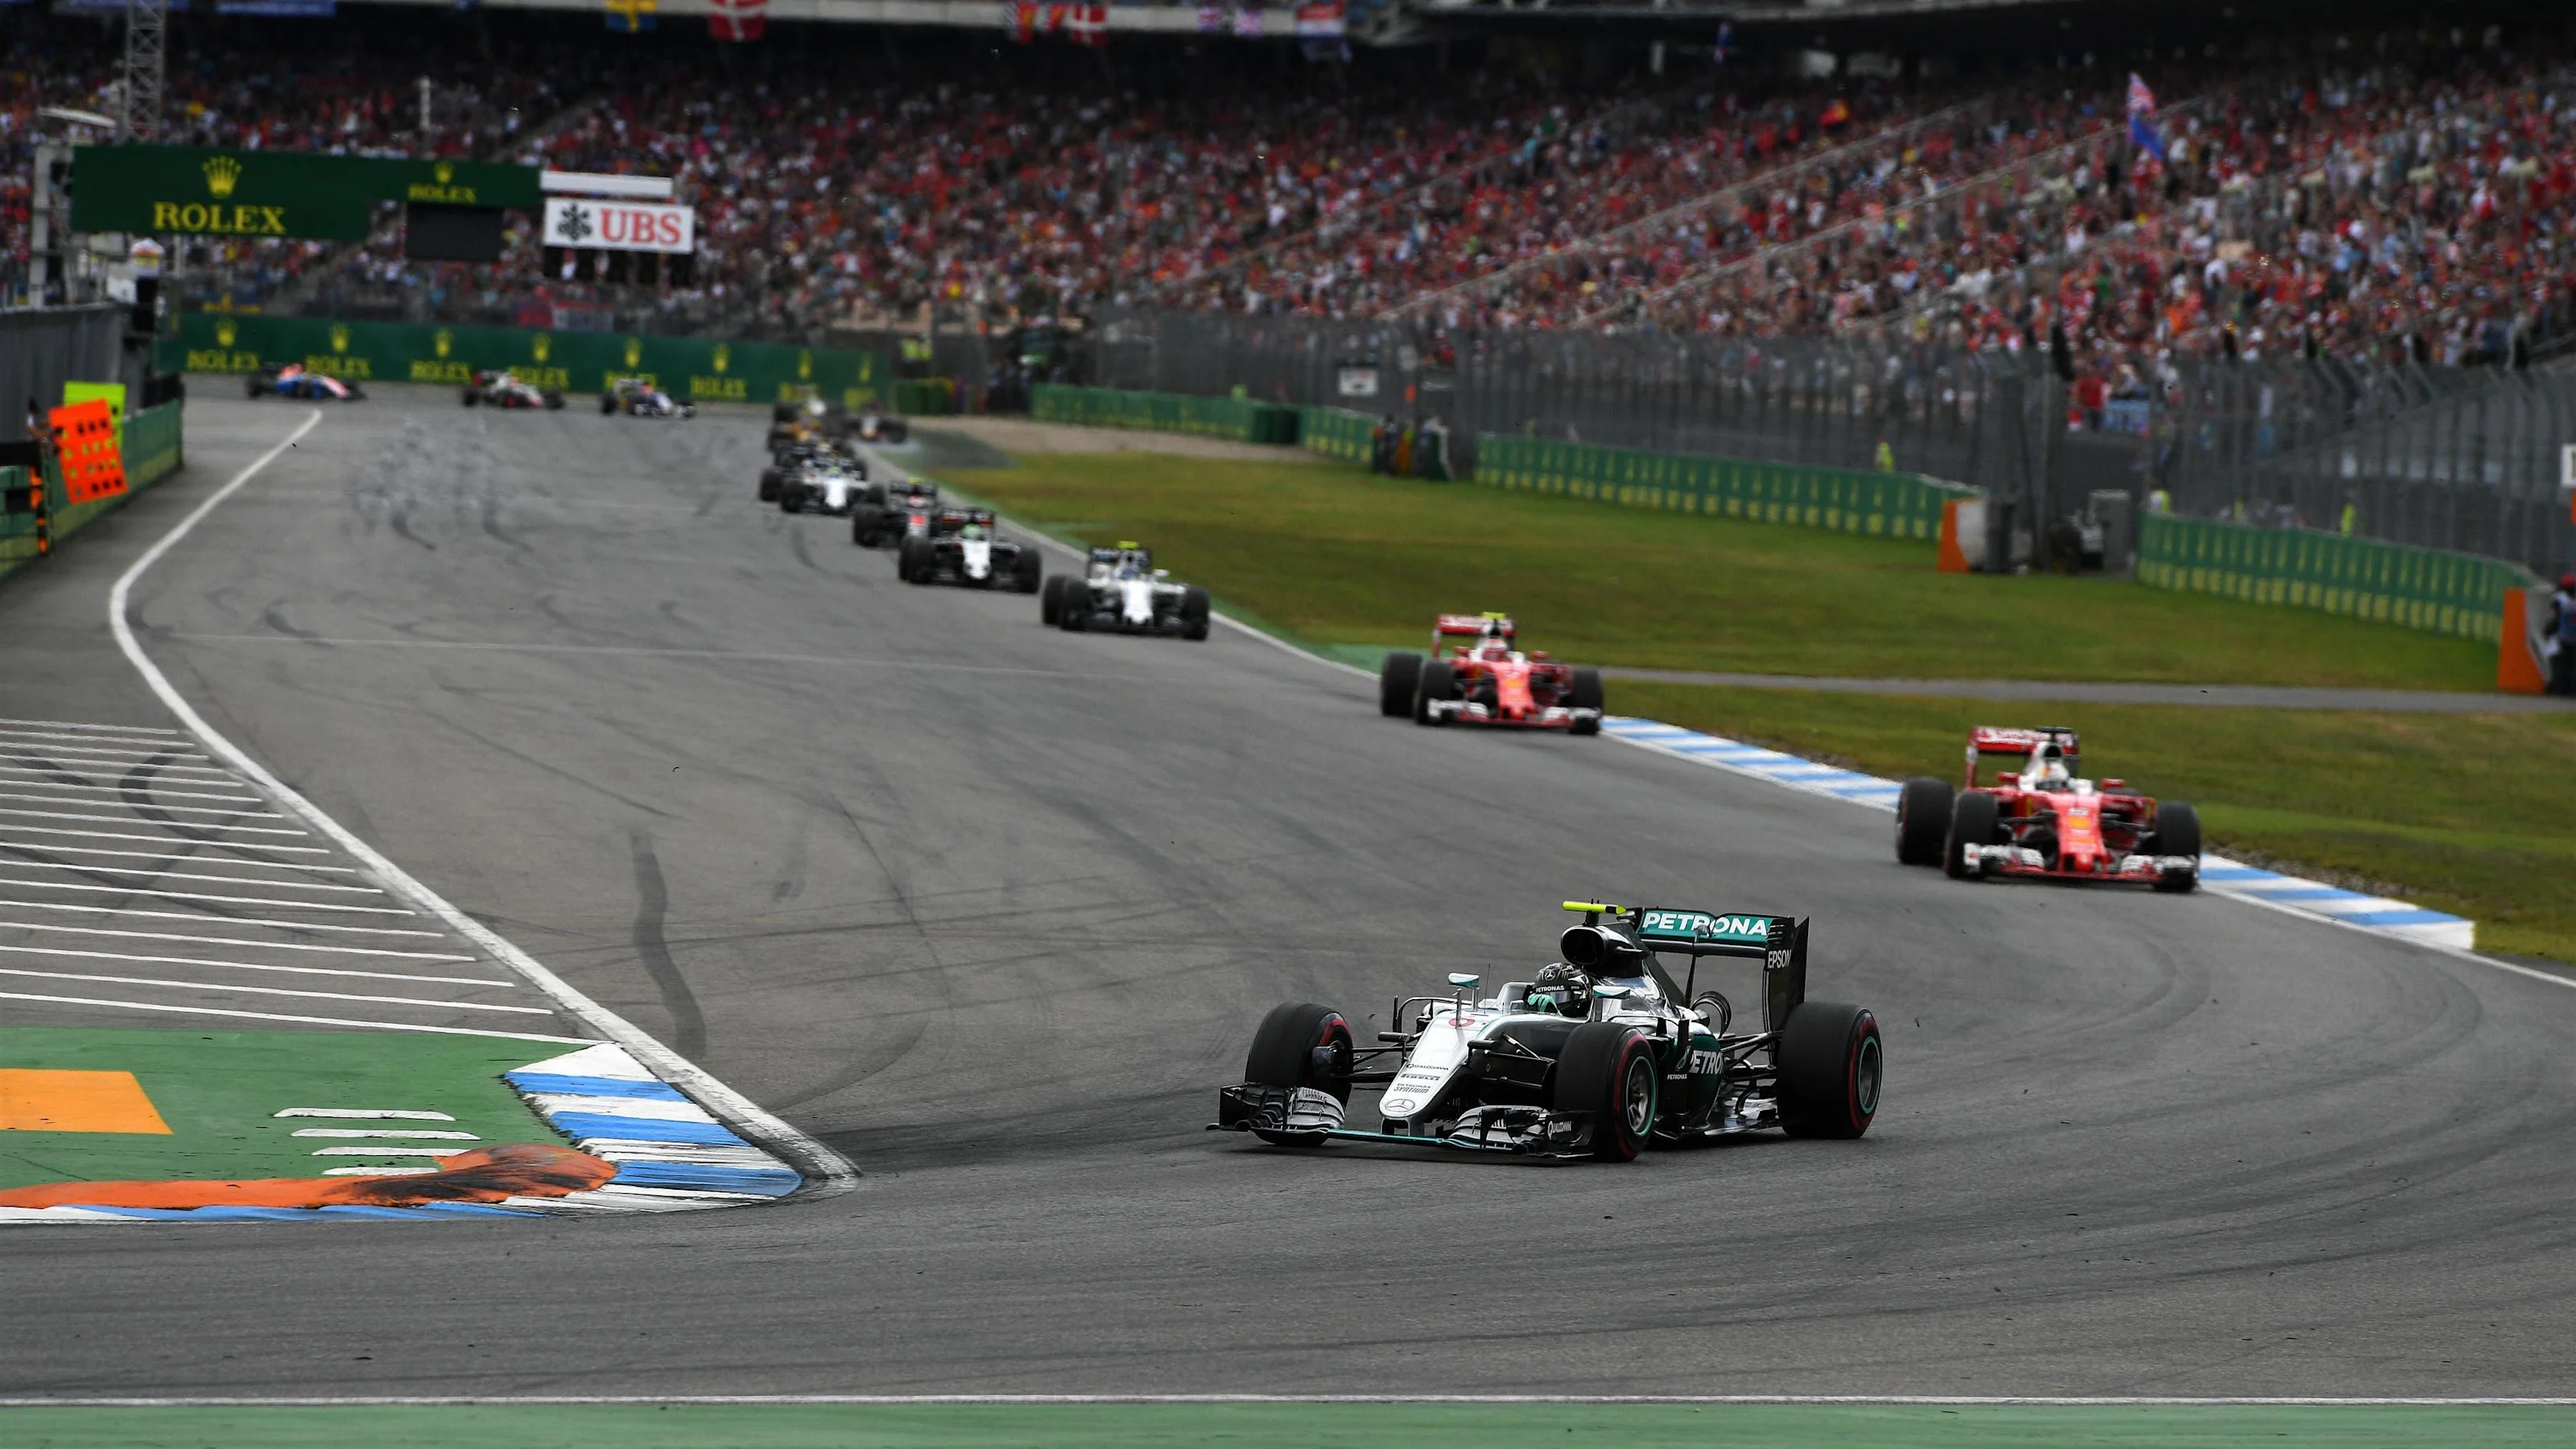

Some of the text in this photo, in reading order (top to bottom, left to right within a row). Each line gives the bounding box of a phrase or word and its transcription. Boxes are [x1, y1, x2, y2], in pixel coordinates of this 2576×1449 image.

[408, 183, 477, 203] ROLEX
[153, 201, 286, 234] ROLEX
[600, 207, 682, 244] UBS
[1642, 911, 1769, 936] PETRONA
[1768, 949, 1792, 969] EPSON
[1535, 985, 1565, 993] PETRONAS
[1689, 1050, 1724, 1075] ETRO
[1547, 1120, 1572, 1141] QUALCOMM
